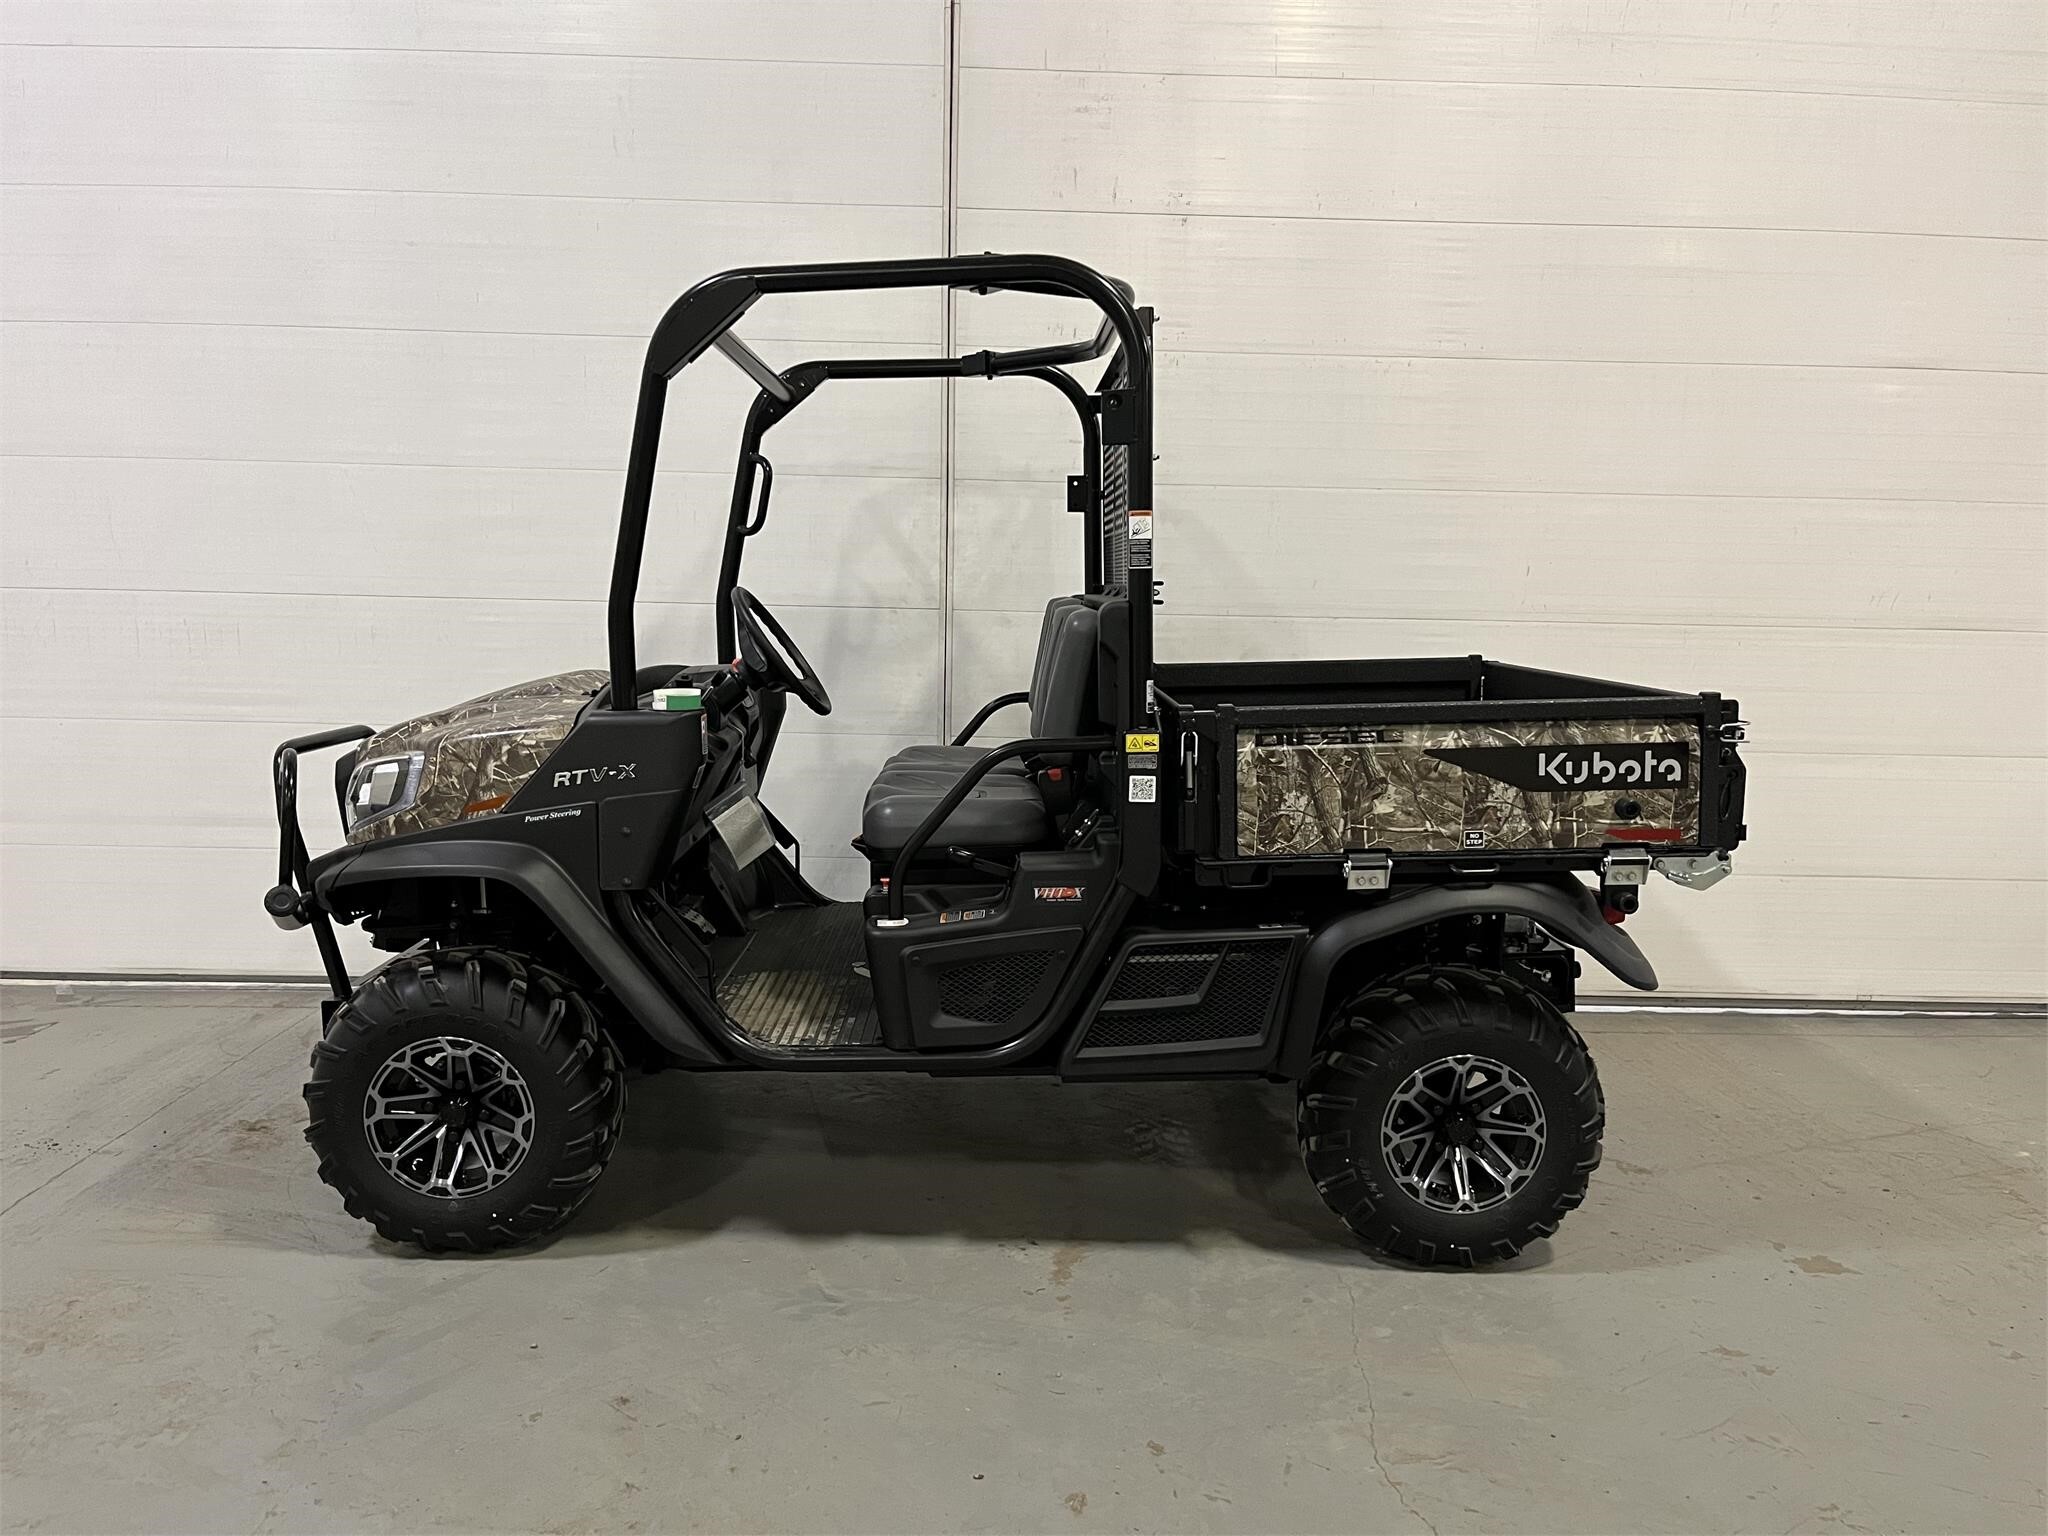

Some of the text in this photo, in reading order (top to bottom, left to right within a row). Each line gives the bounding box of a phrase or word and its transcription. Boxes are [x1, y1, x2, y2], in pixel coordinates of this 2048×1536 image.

[1255, 730, 1404, 747] DIESEL
[553, 763, 637, 788] RTV-X
[1538, 750, 1682, 785] Kubota
[524, 808, 582, 823] Power Steering
